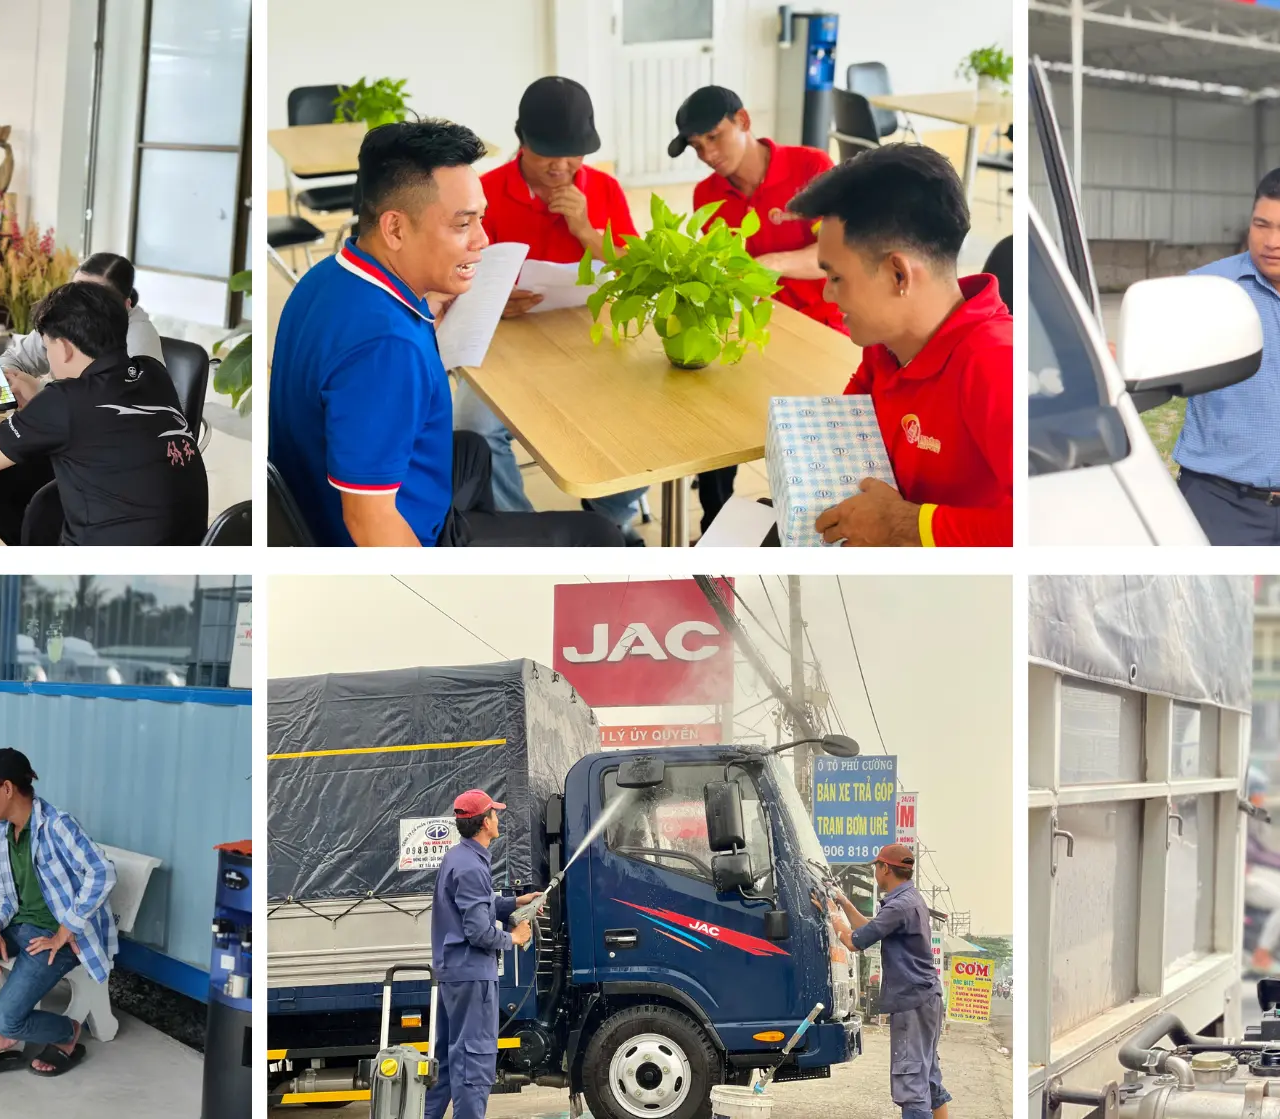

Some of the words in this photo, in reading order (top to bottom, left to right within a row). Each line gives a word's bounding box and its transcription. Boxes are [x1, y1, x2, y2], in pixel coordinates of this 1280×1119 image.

[562, 620, 720, 663] JAC
[609, 727, 626, 742] LÝ
[841, 758, 859, 771] PHÚ
[862, 758, 893, 771] CƯỜNG
[817, 778, 836, 802] BÁN
[838, 783, 851, 801] XE
[853, 776, 871, 801] TRẢ
[874, 777, 894, 801] GÓP
[817, 816, 843, 840] TRẠM
[846, 814, 868, 836] BƠM
[847, 845, 869, 857] 818
[688, 921, 720, 936] JAC
[954, 961, 990, 977] CƠM
